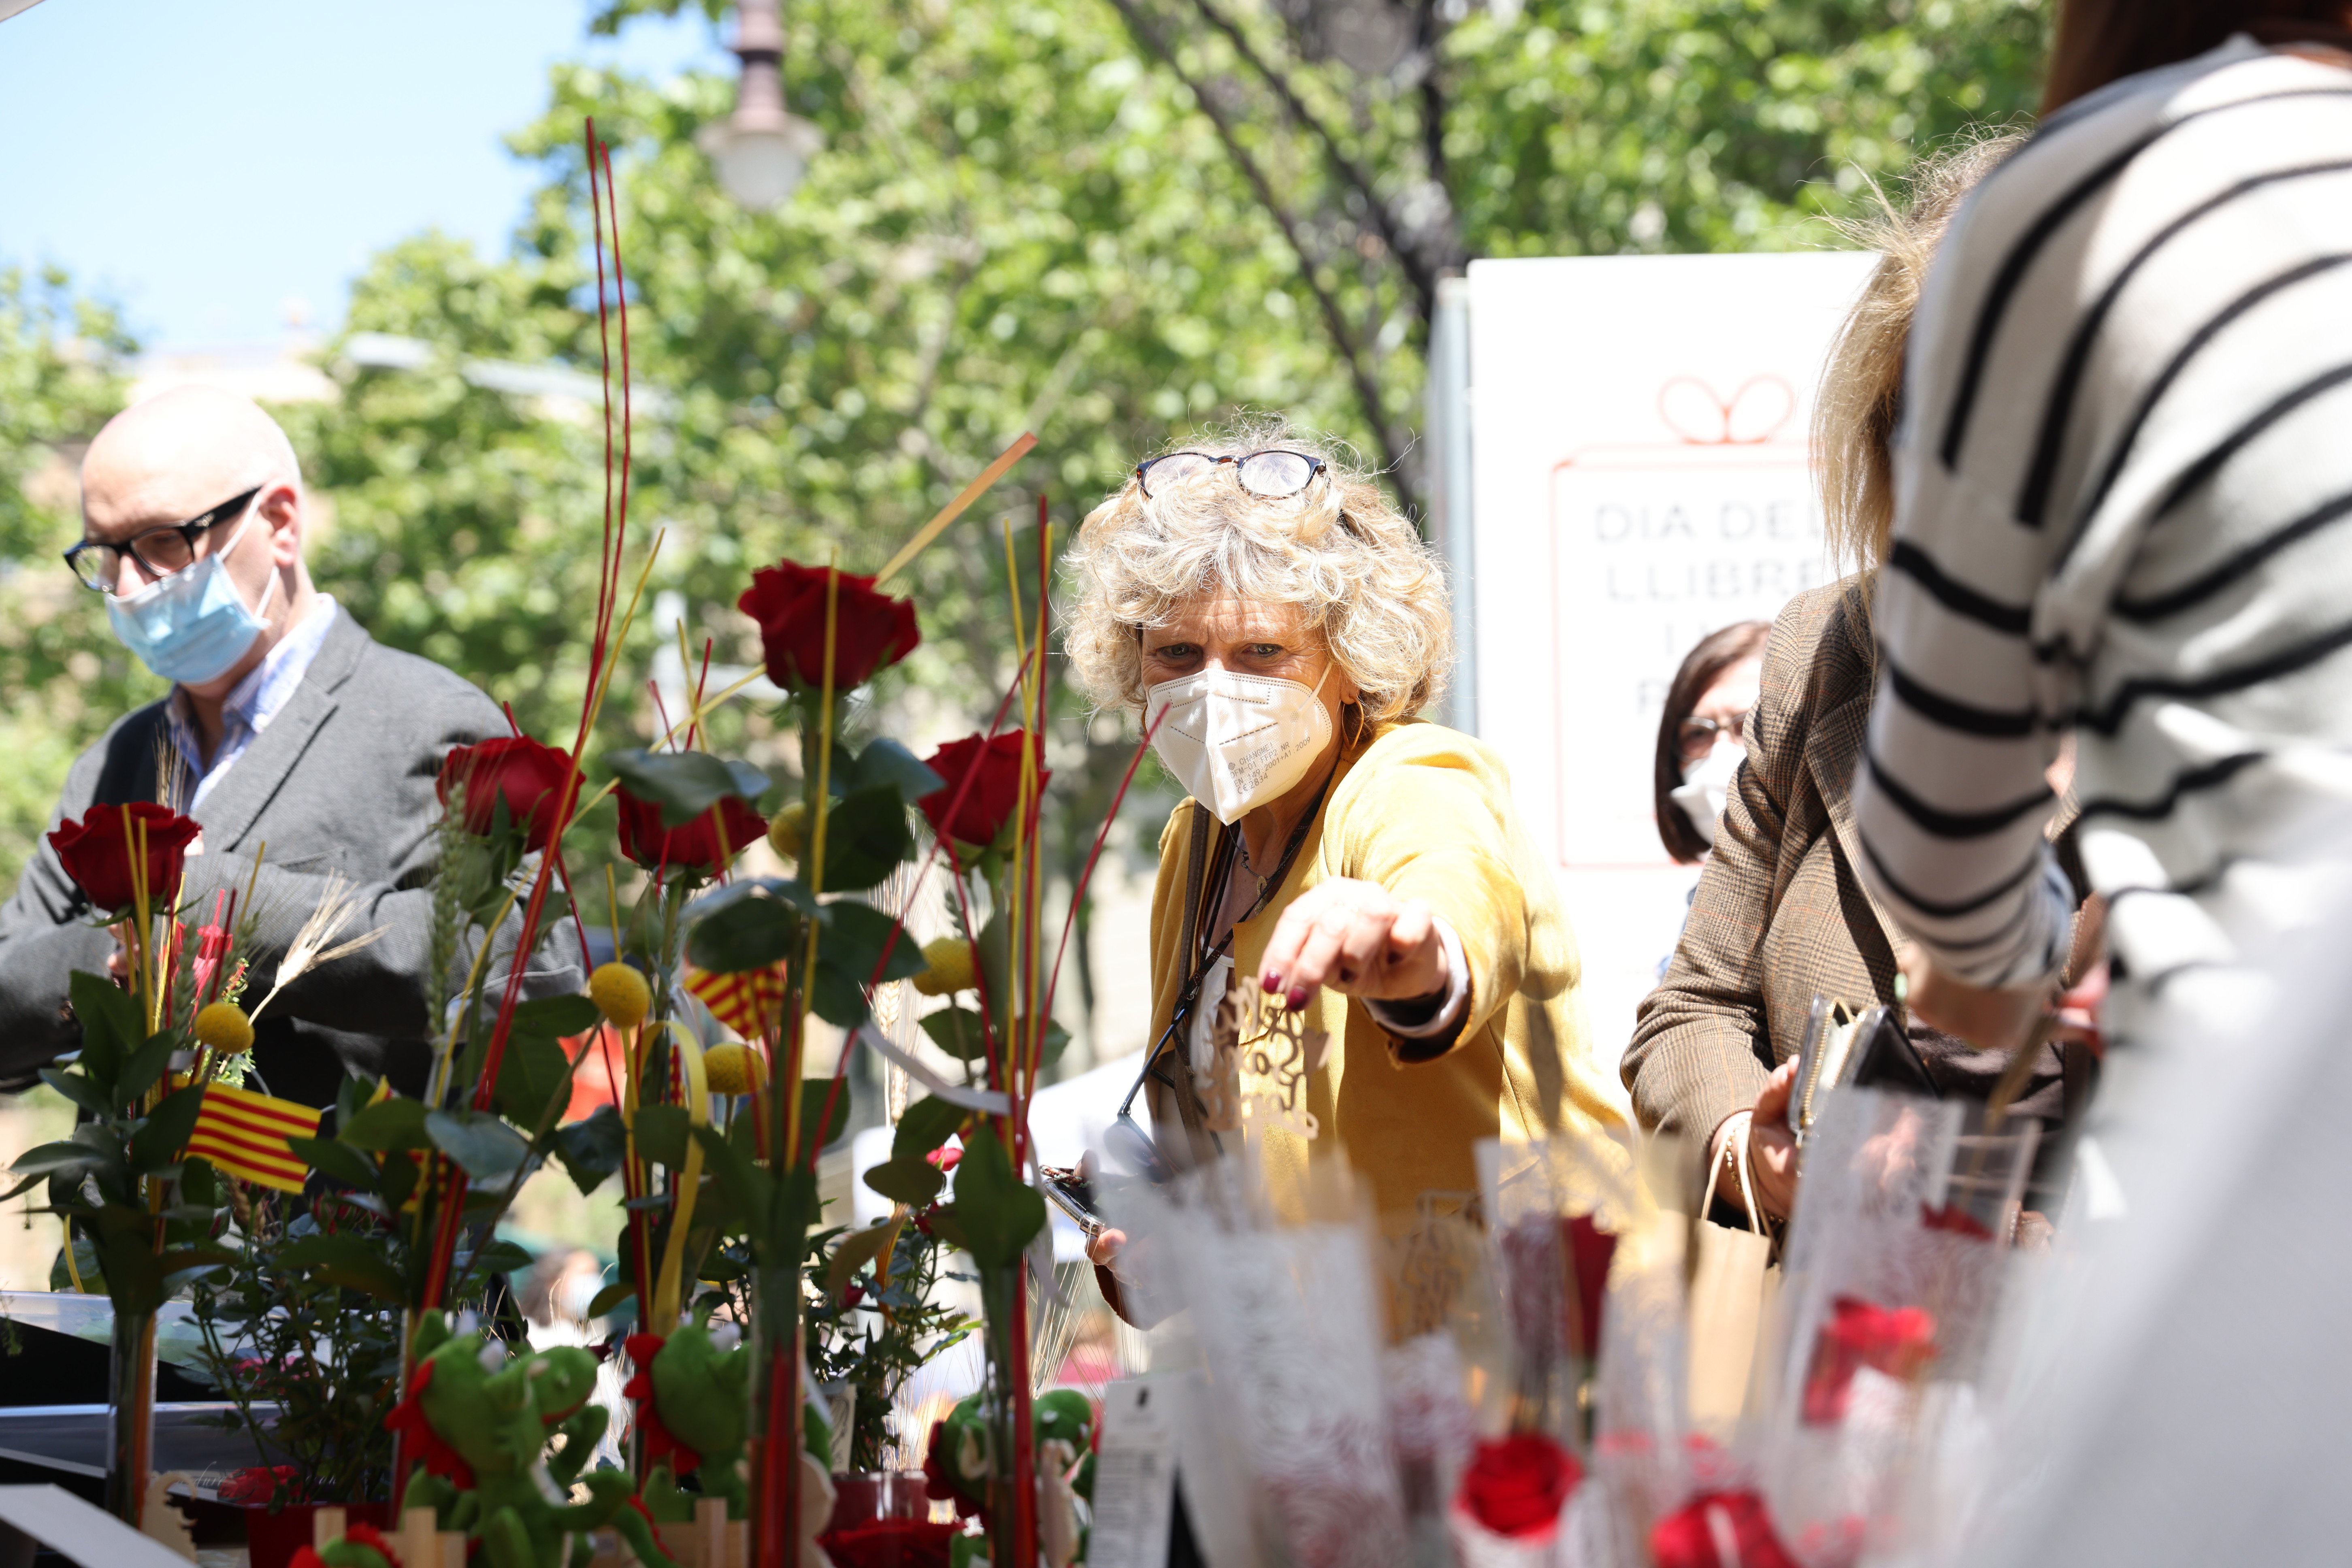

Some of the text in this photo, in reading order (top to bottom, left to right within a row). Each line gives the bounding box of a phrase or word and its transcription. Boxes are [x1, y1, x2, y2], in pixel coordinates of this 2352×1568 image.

[1596, 504, 1694, 542] DIA
[1239, 742, 1273, 765] CHANGMEI
[1260, 749, 1278, 763] FFP2
[1281, 742, 1290, 752] NR
[1234, 778, 1244, 787] EN
[1249, 773, 1268, 789] 2834
